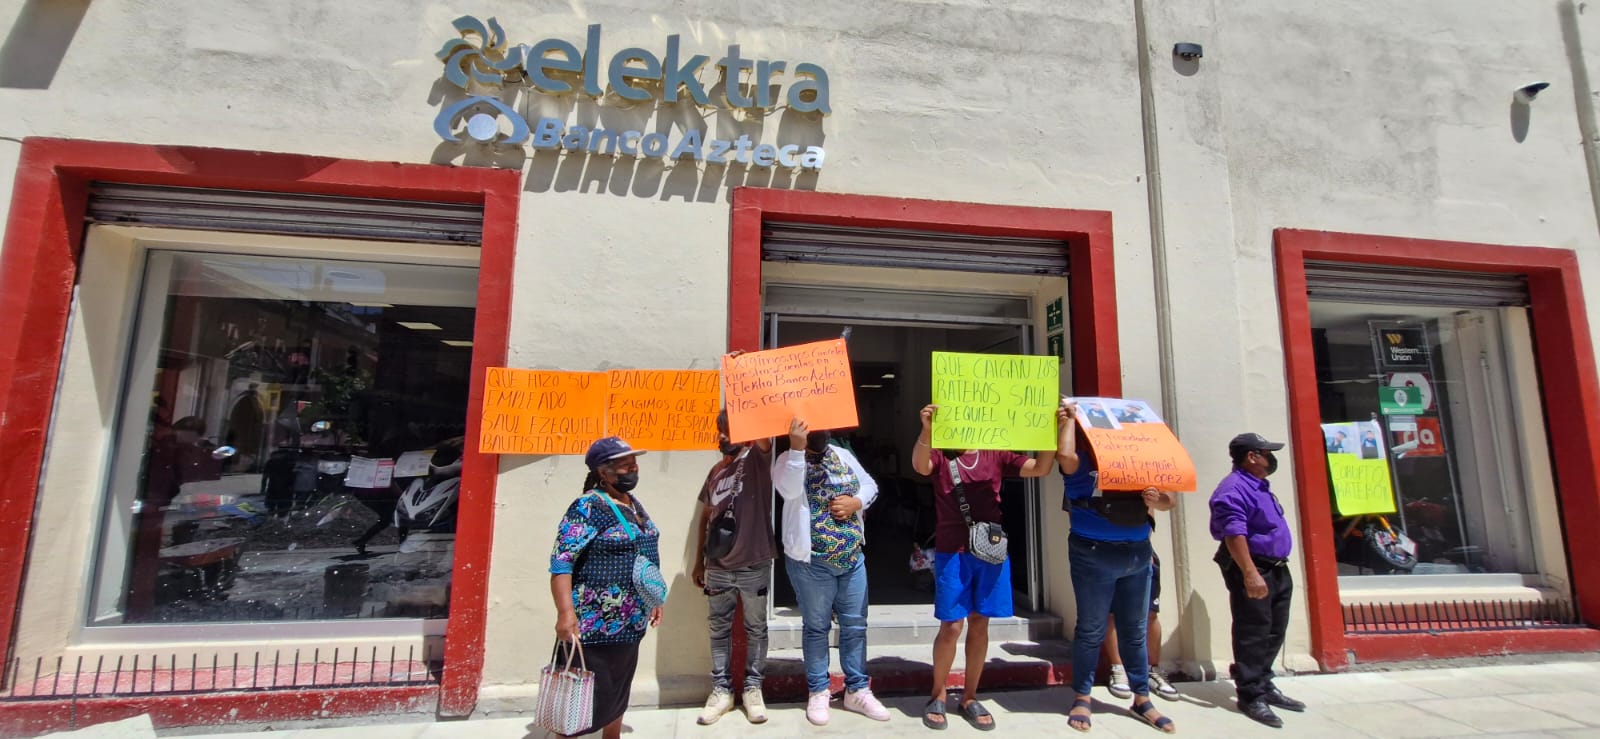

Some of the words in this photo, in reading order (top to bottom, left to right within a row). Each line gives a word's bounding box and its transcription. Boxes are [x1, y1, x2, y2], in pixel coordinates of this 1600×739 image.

[525, 24, 831, 116] elektra
[1390, 346, 1419, 354] Western
[1391, 353, 1412, 361] Union
[936, 354, 965, 377] QUE
[973, 358, 1031, 380] CAIGAN
[1037, 359, 1058, 379] LOS
[488, 369, 517, 388] QUE
[528, 373, 560, 388] HIZO
[568, 373, 590, 390] SU
[610, 370, 664, 391] BANCO
[672, 371, 720, 393] AZTECA
[776, 374, 808, 387] Banco
[810, 368, 846, 384] Azteca
[487, 390, 567, 410] EMPLEADO
[760, 382, 838, 407] responsables
[936, 379, 1001, 405] RATEROS
[1010, 384, 1048, 407] SAUL
[675, 398, 697, 413] QUE
[703, 398, 720, 413] SE
[482, 410, 520, 433] SAUL
[529, 416, 604, 434] EZEQUIEL
[611, 411, 658, 428] HAGAN
[934, 406, 997, 423] EZEQUIEL
[1025, 412, 1049, 429] SUS
[482, 433, 553, 453] BAUTISTA
[662, 429, 686, 441] DEL
[933, 426, 1011, 447] COMPLICES
[1101, 471, 1145, 486] Bautista
